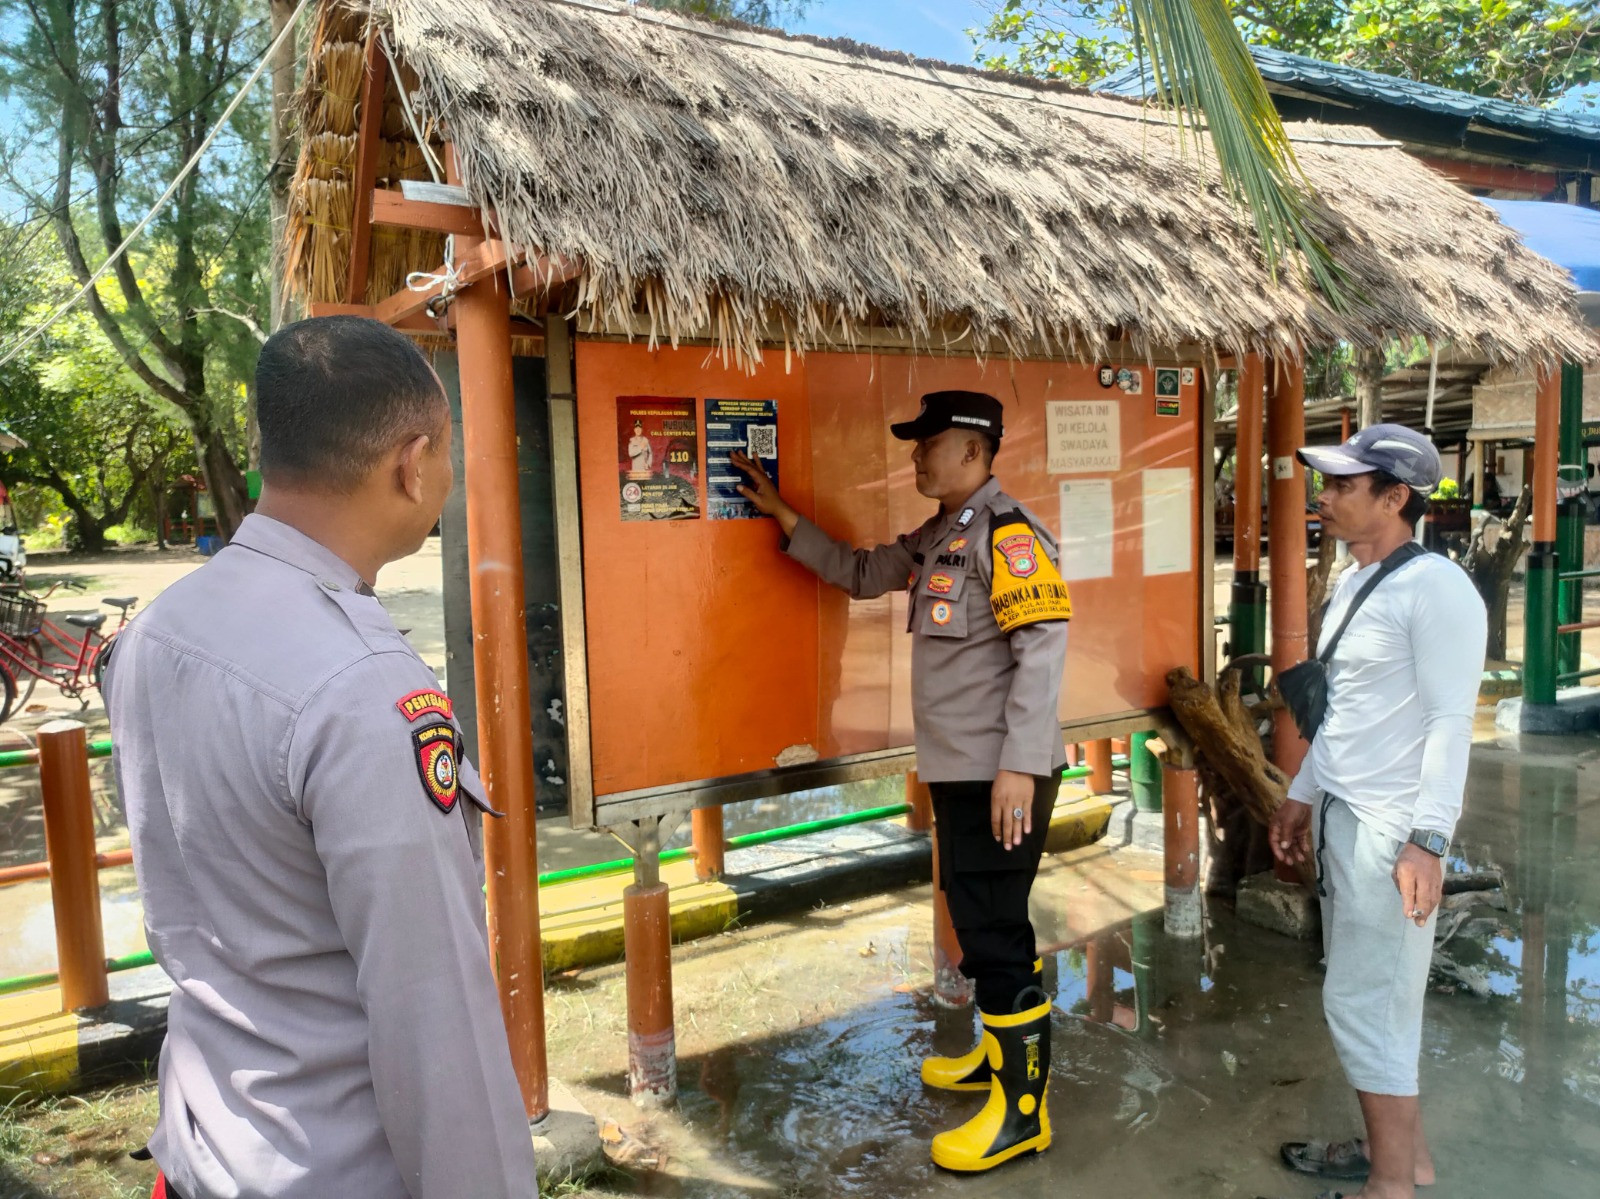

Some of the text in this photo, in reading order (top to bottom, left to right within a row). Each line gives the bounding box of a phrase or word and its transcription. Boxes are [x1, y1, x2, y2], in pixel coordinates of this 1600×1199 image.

[1054, 405, 1109, 417] WISATA INI
[1057, 422, 1108, 434] DI KELOLA
[1060, 439, 1109, 451] SWADAYA
[670, 451, 689, 463] 110
[1050, 455, 1119, 469] MASYARAKAT
[935, 554, 966, 568] POLRI
